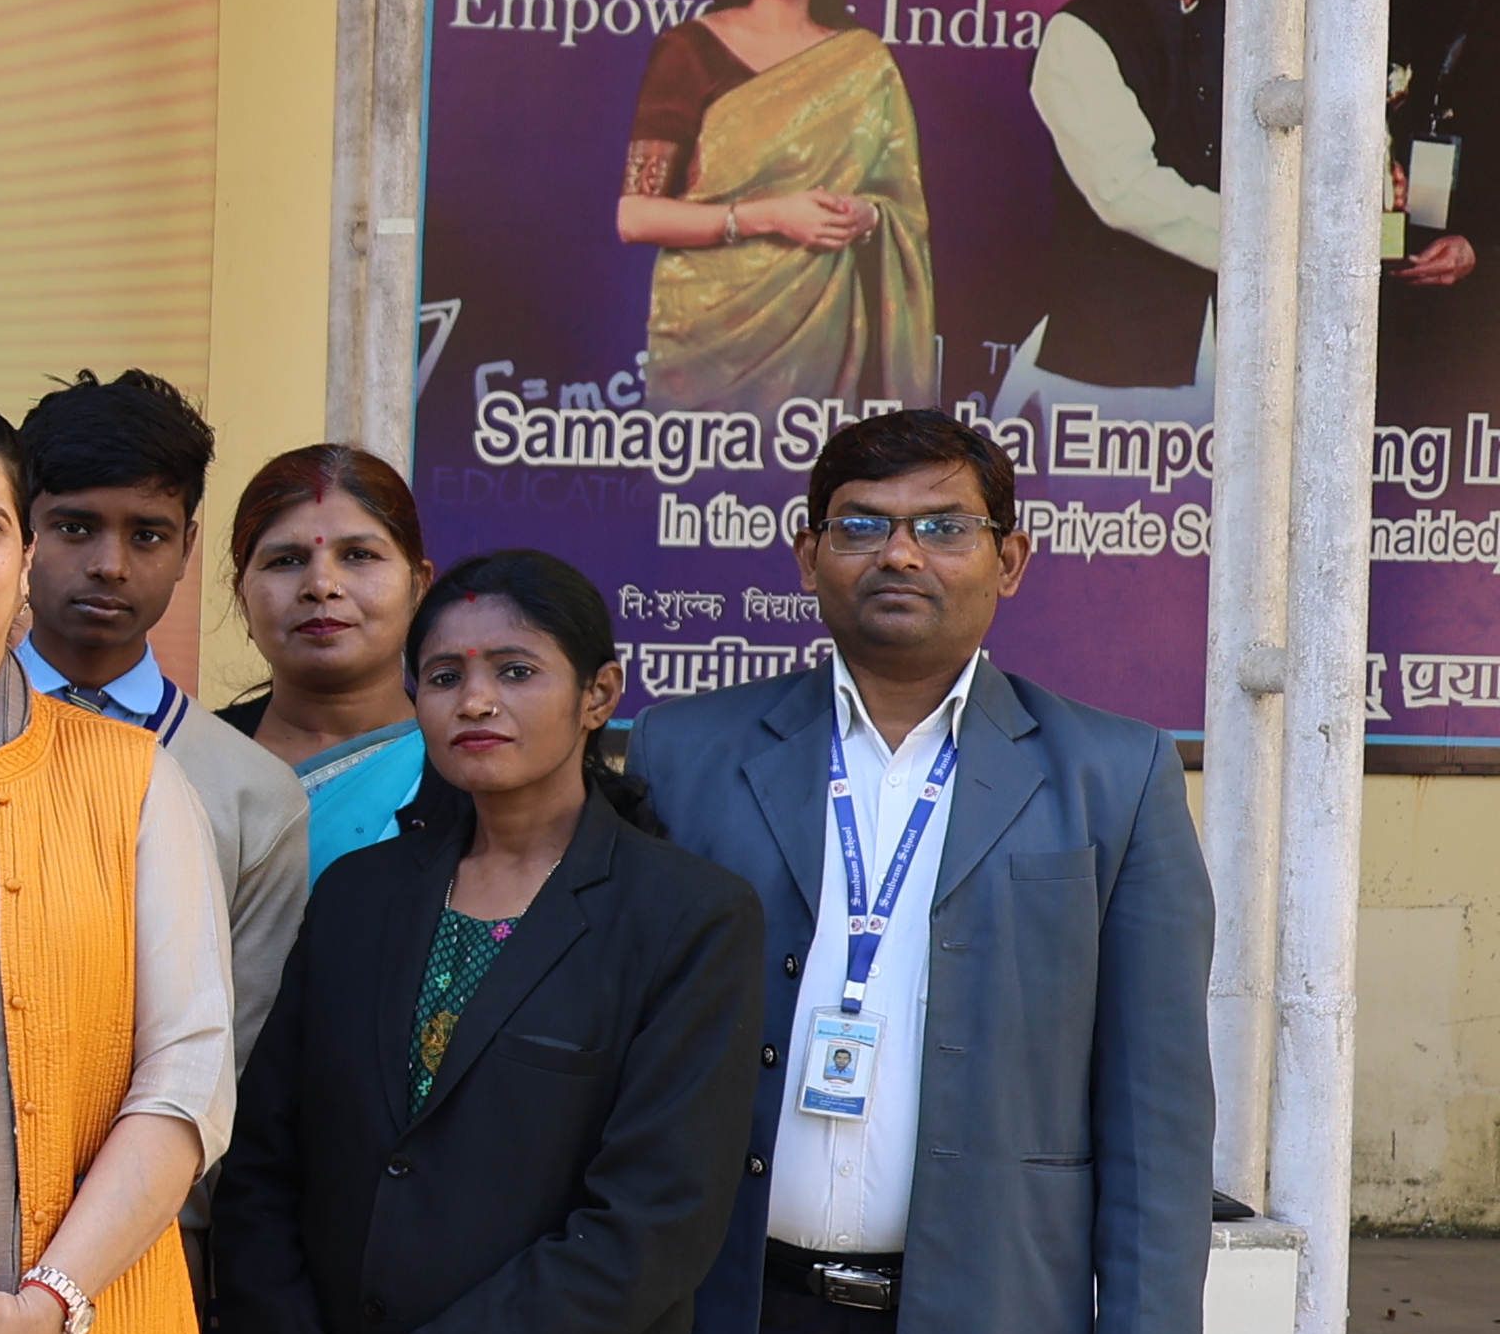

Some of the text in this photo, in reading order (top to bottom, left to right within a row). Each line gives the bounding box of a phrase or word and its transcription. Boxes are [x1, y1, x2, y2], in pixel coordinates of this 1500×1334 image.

[474, 391, 763, 484] Samagra
[658, 493, 699, 547] In
[707, 491, 777, 548] the
[1023, 499, 1168, 565] Private
[742, 587, 822, 623] विद्याल
[841, 826, 864, 908] Sunbeam School
[879, 828, 918, 910] Sunbeam School
